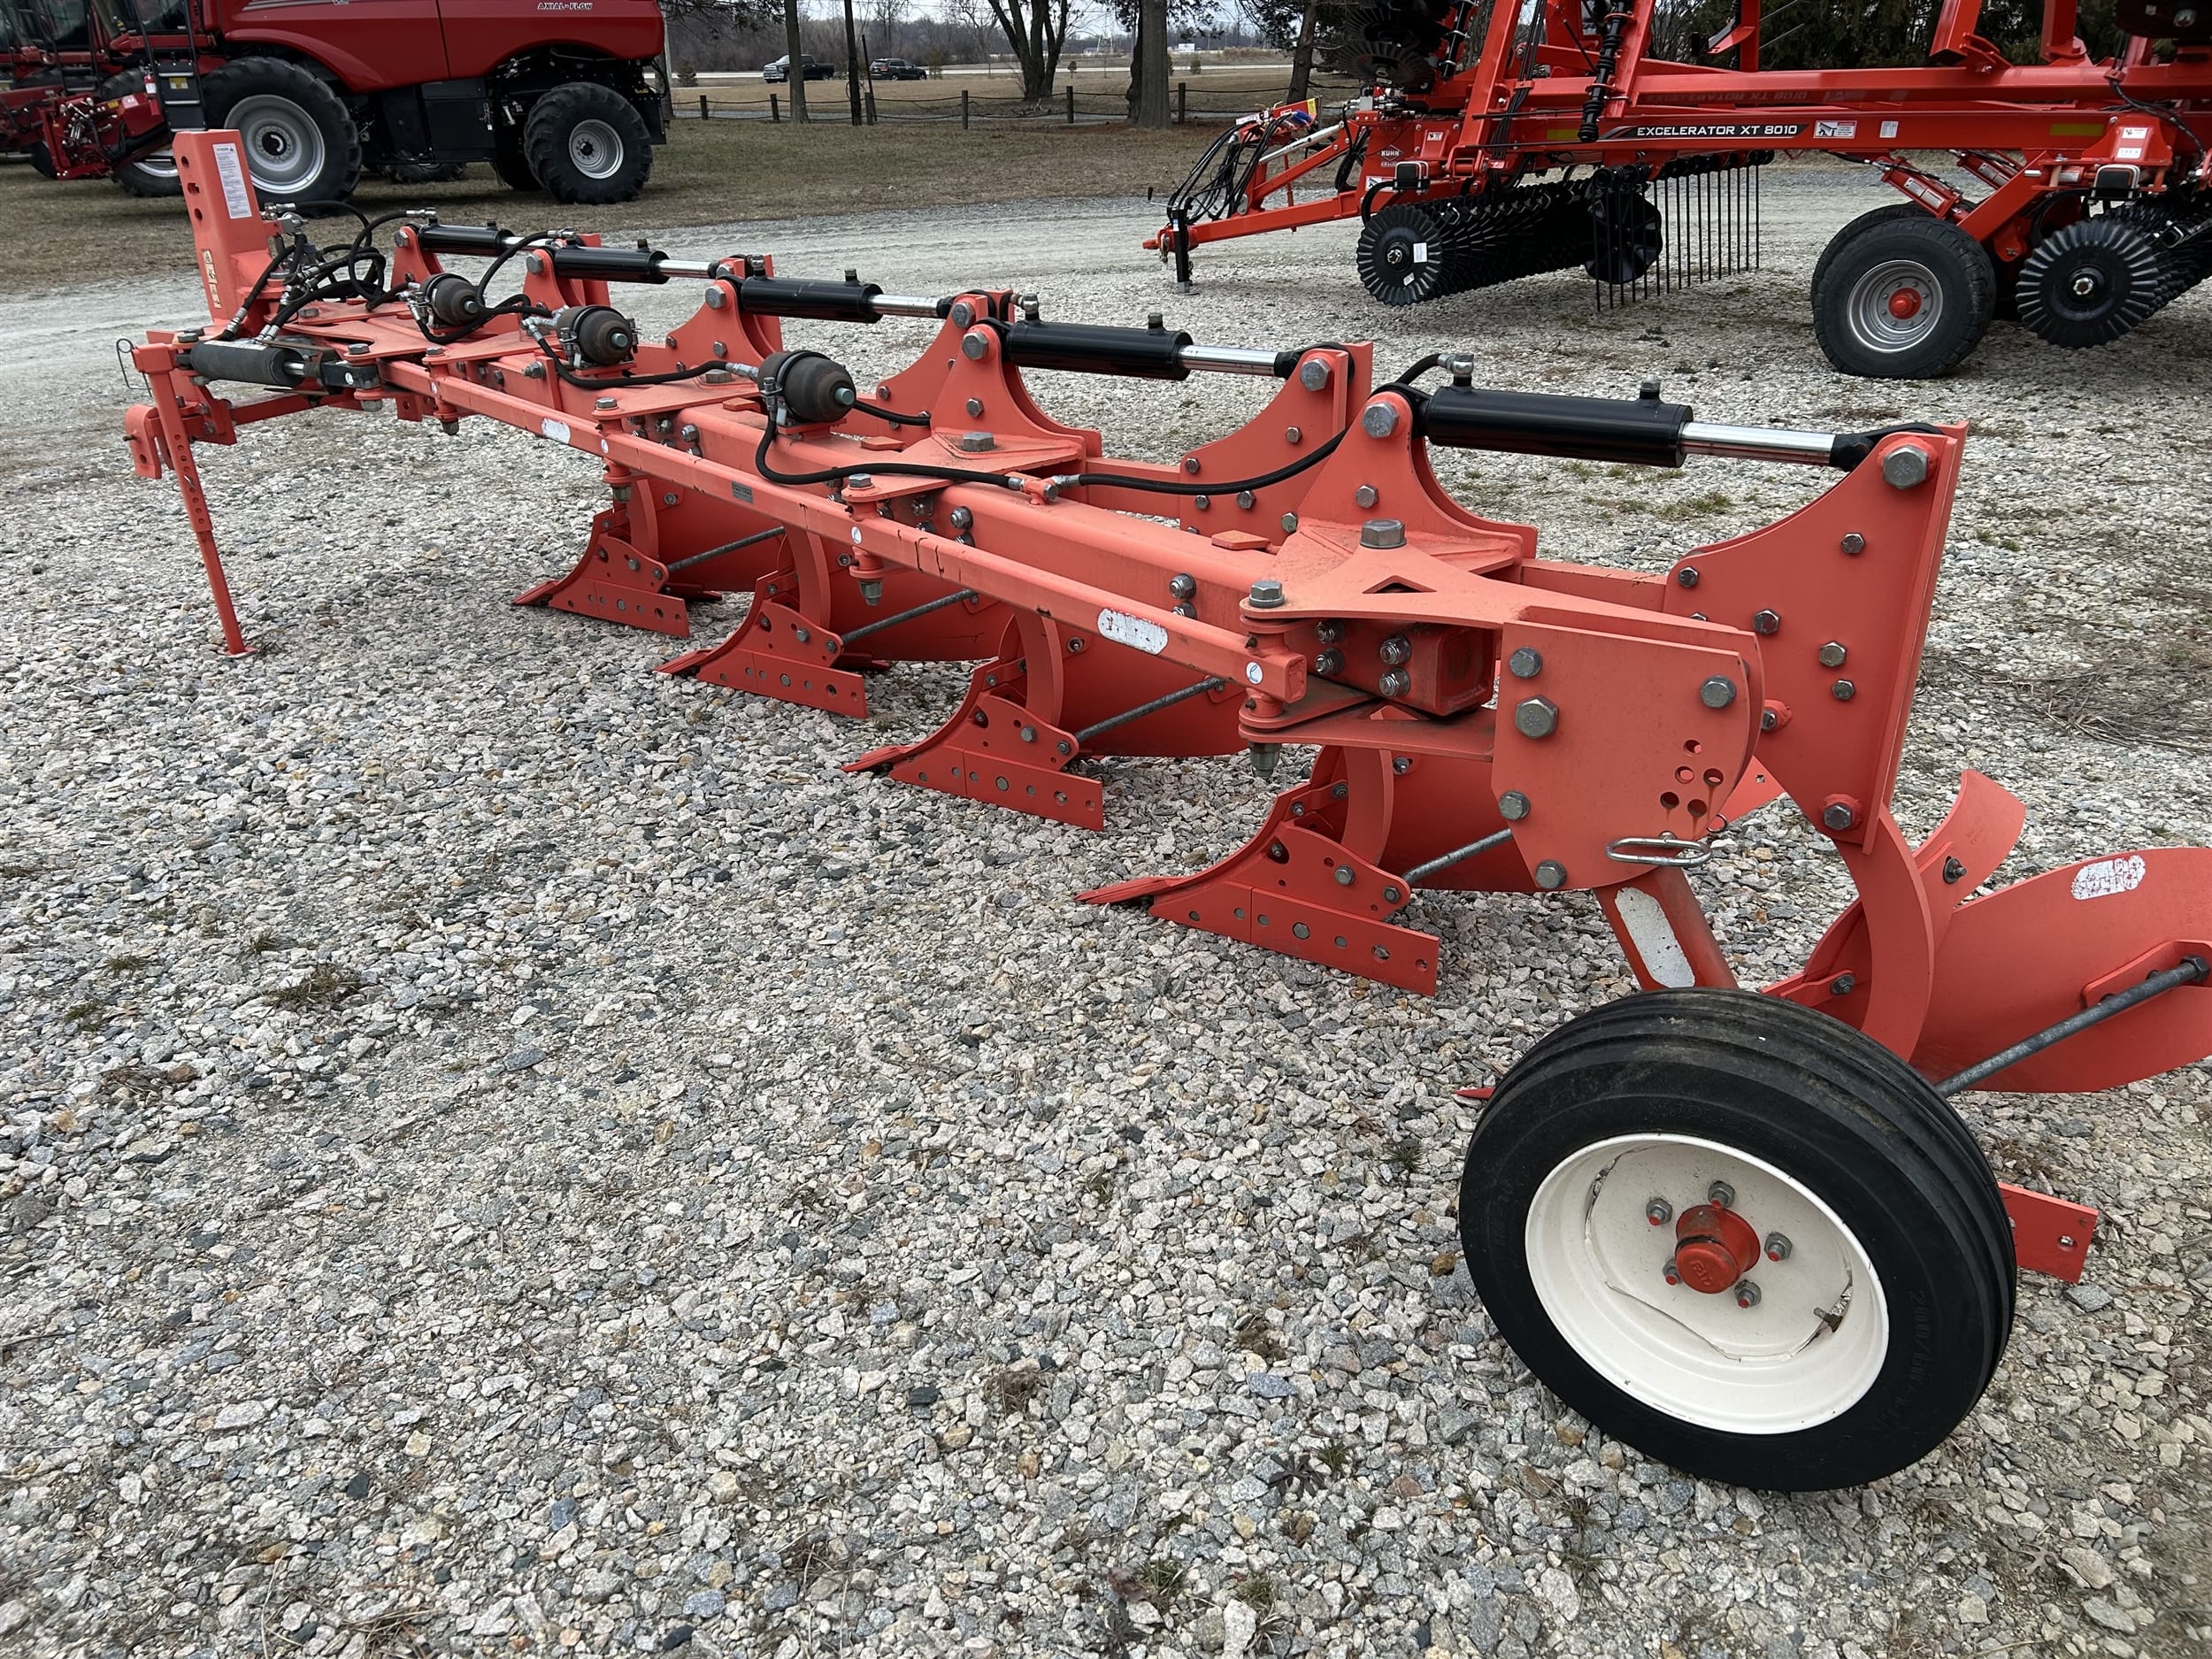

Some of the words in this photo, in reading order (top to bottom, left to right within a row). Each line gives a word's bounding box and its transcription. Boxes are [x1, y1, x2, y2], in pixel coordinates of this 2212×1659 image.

[1637, 126, 1735, 136] EXCELERATOR
[1740, 126, 1760, 134] XT
[1764, 126, 1797, 134] 8010
